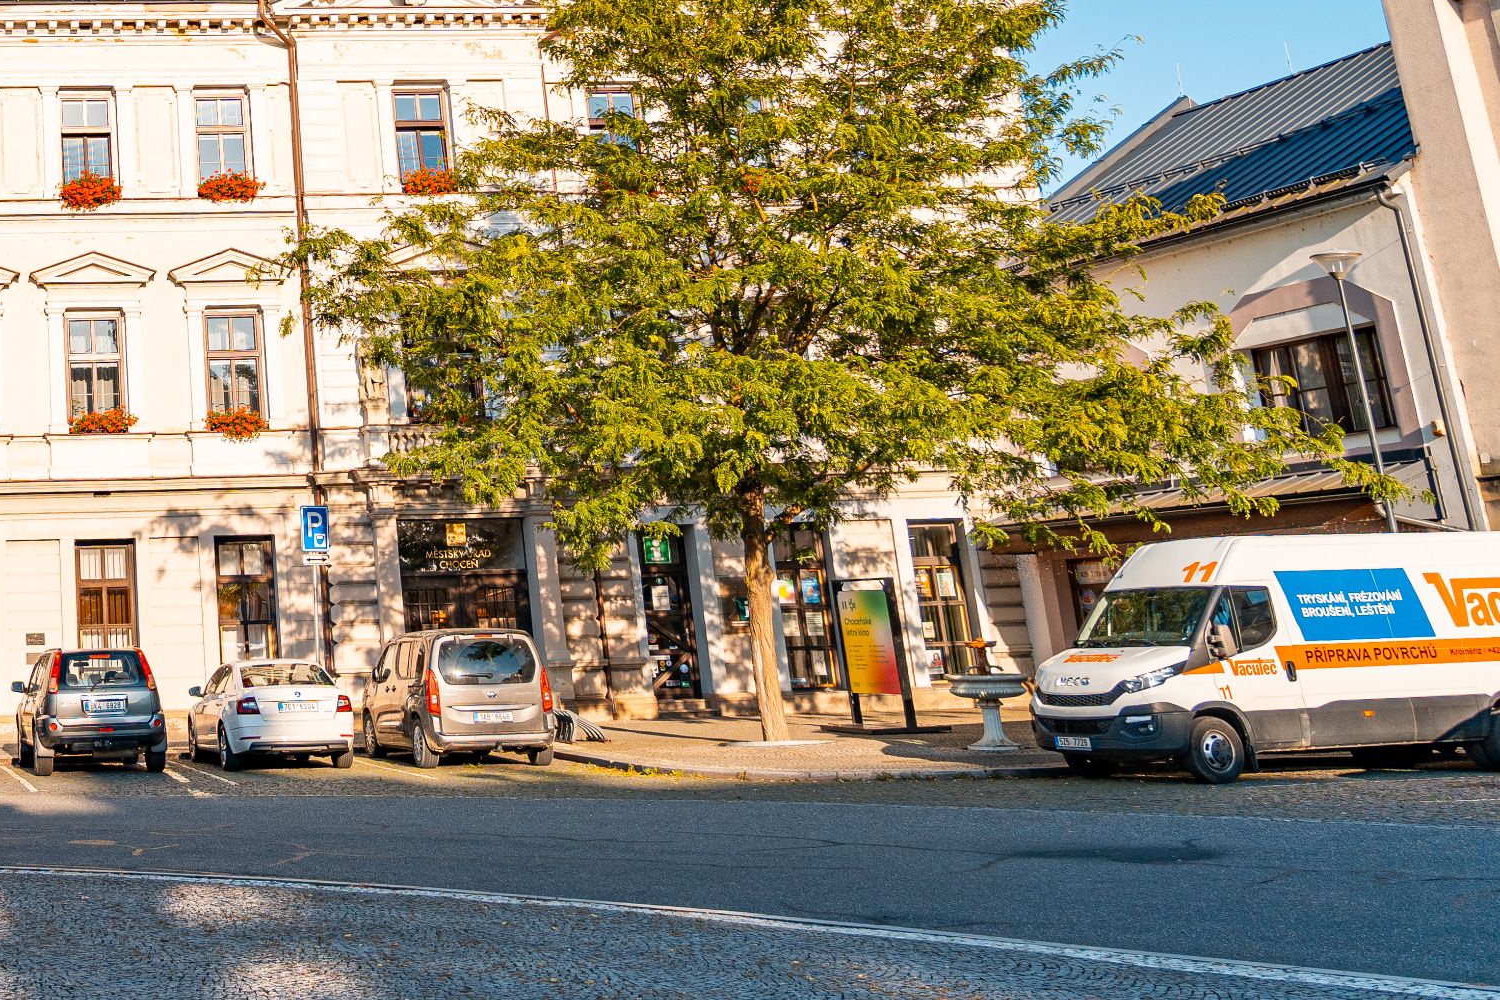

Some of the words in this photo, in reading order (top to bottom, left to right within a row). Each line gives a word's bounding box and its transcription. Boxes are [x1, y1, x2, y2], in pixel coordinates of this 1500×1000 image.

[307, 511, 323, 537] P
[426, 546, 464, 559] MĚSTSKÝ
[440, 559, 479, 569] CHOCEŇ
[1181, 561, 1218, 583] 11
[1297, 590, 1349, 605] TRYSKÁNÍ,
[1348, 588, 1403, 602] FRÉZOVÁNÍ
[1301, 604, 1355, 617] BROUŠENÍ,
[1355, 602, 1396, 615] LEŠTĚNÍ
[1305, 647, 1372, 663] PŘÍPRAVA
[1373, 642, 1437, 661] POVRCHŮ
[1219, 684, 1233, 700] 11
